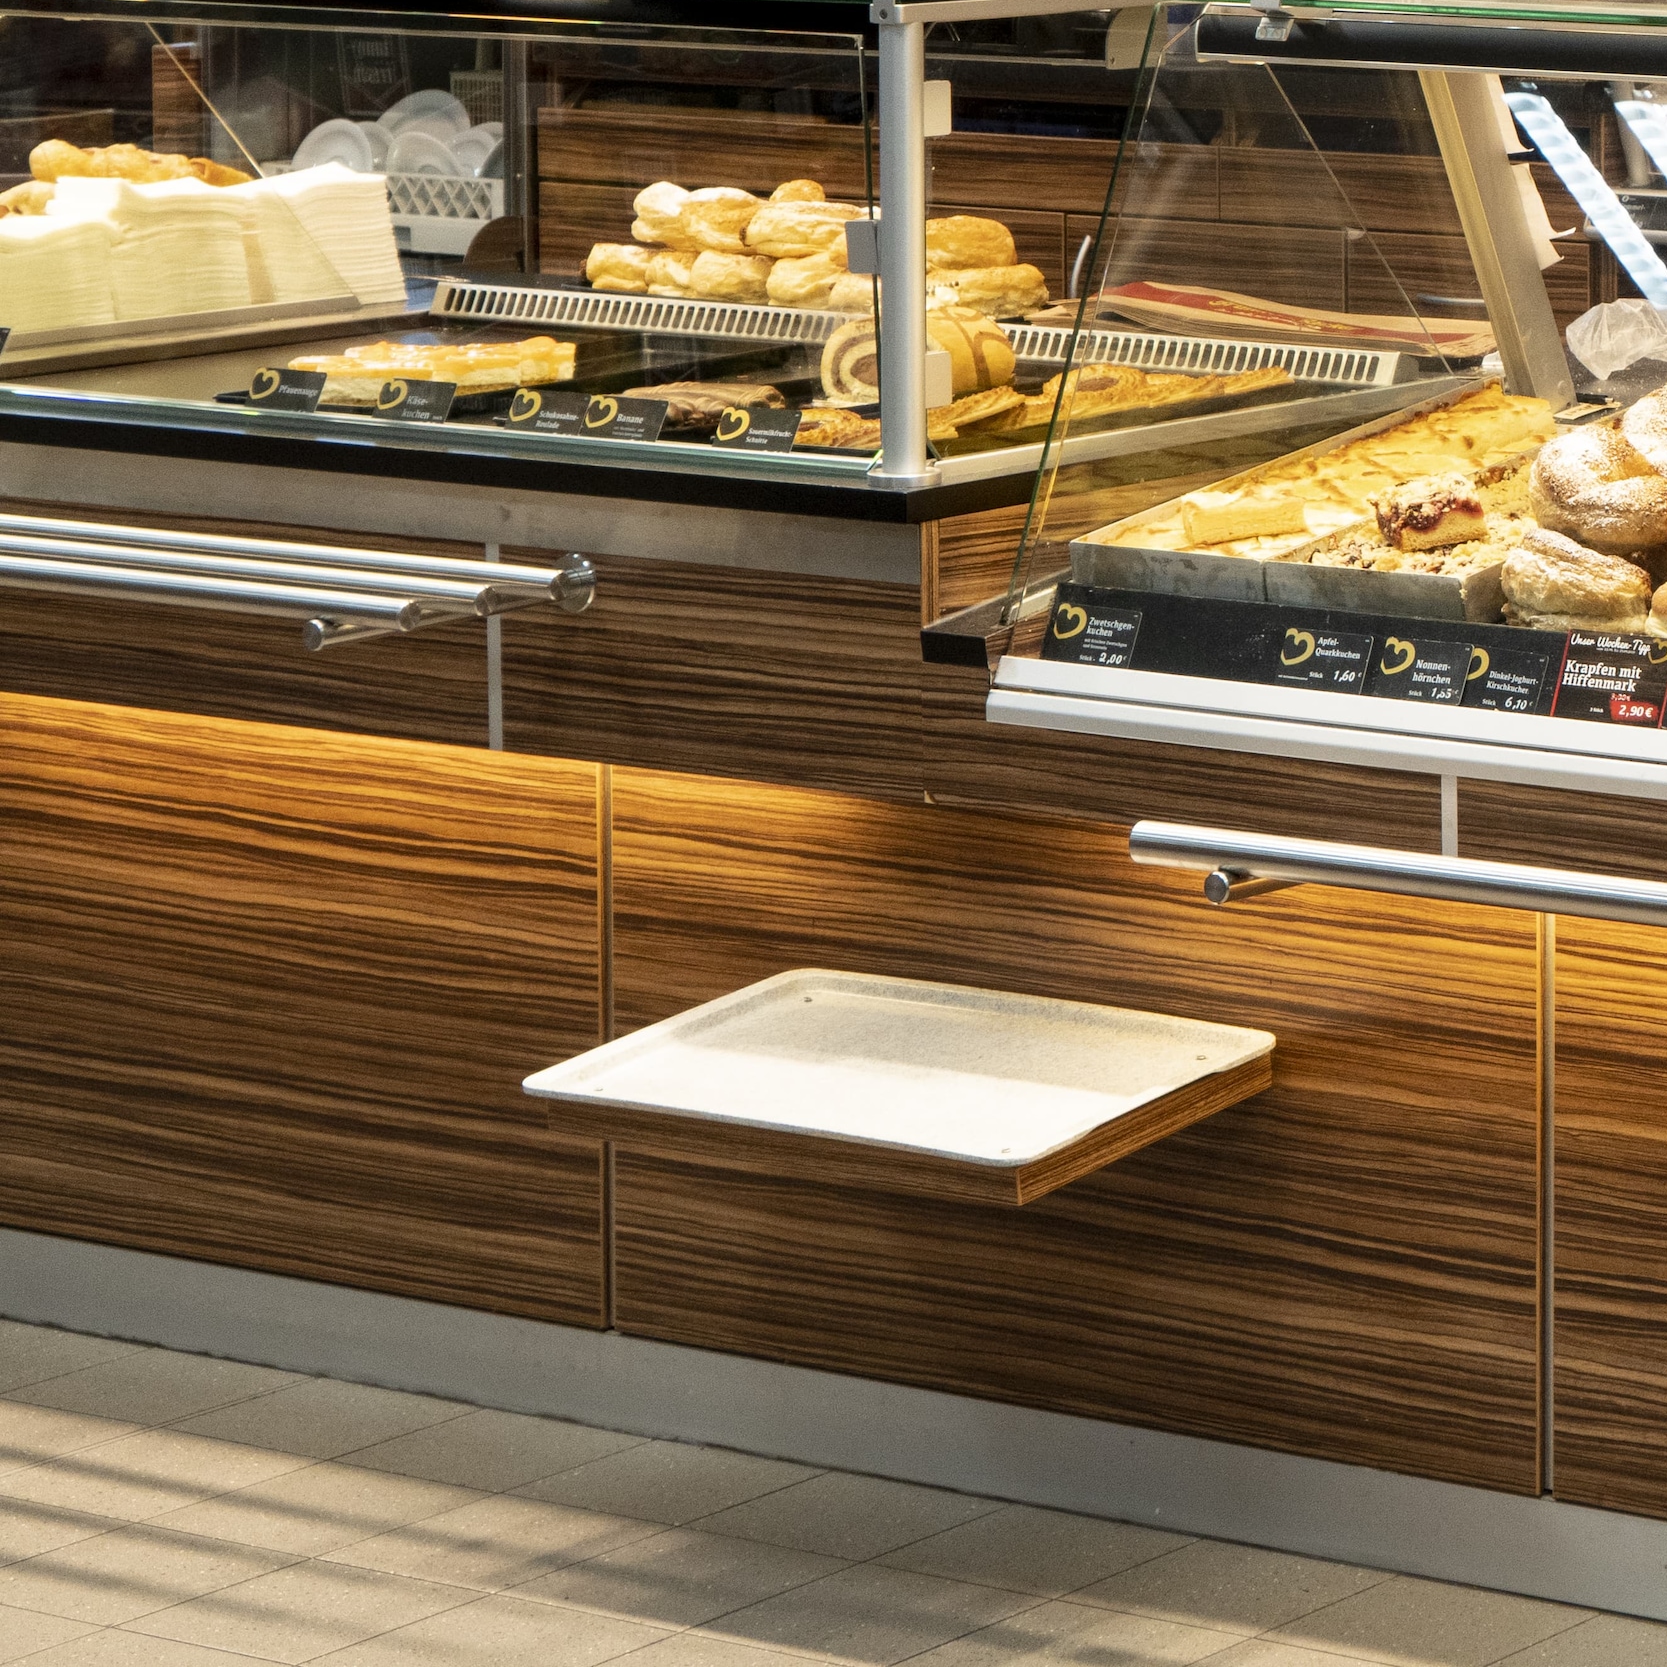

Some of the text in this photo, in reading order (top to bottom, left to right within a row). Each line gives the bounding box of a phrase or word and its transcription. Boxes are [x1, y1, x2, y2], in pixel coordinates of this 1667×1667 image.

[407, 396, 428, 406] Käse-
[401, 409, 430, 419] kuchen
[617, 413, 644, 424] Banane
[1090, 617, 1135, 631] Zwetschgen-
[1087, 626, 1113, 637] kuchen
[1318, 637, 1339, 647] Apfel-
[1571, 634, 1651, 656] Unser Wochen-Tipp
[1099, 652, 1122, 665] 2,00
[1315, 647, 1360, 659] Quarkkuchen
[1416, 659, 1450, 671] Nonnen-
[1565, 660, 1642, 679] Krapfen mit
[1333, 670, 1355, 682] 1,60
[1412, 672, 1450, 684] hörnchen
[1489, 670, 1539, 685] Dinkel-Joghurt-
[1562, 673, 1636, 693] Hiffenmark
[1505, 697, 1527, 710] 6,10
[1618, 704, 1644, 718] 2,90
